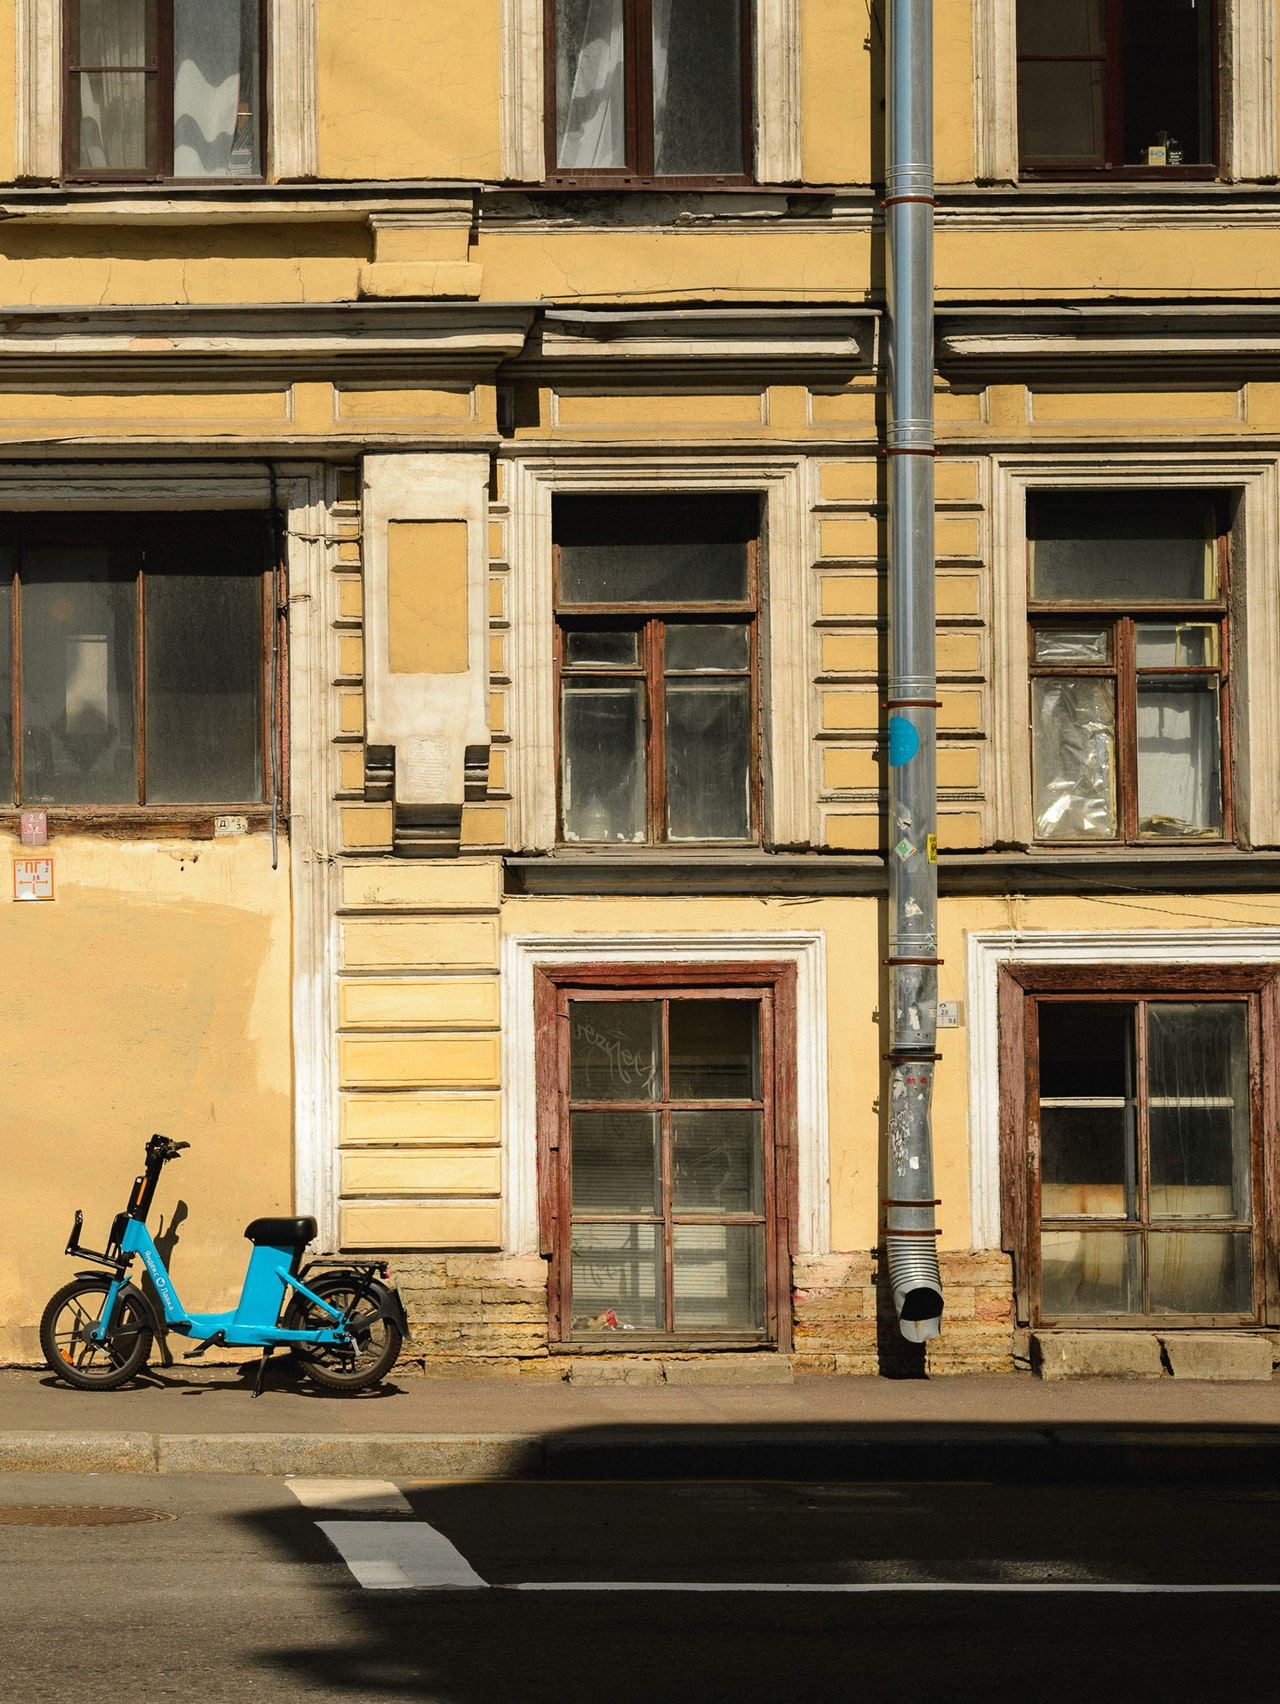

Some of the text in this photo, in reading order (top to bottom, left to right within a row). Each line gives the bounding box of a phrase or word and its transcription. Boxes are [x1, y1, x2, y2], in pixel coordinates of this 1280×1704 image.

[25, 862, 41, 873] ПГ
[145, 1250, 174, 1310] Яндекс Лавка
